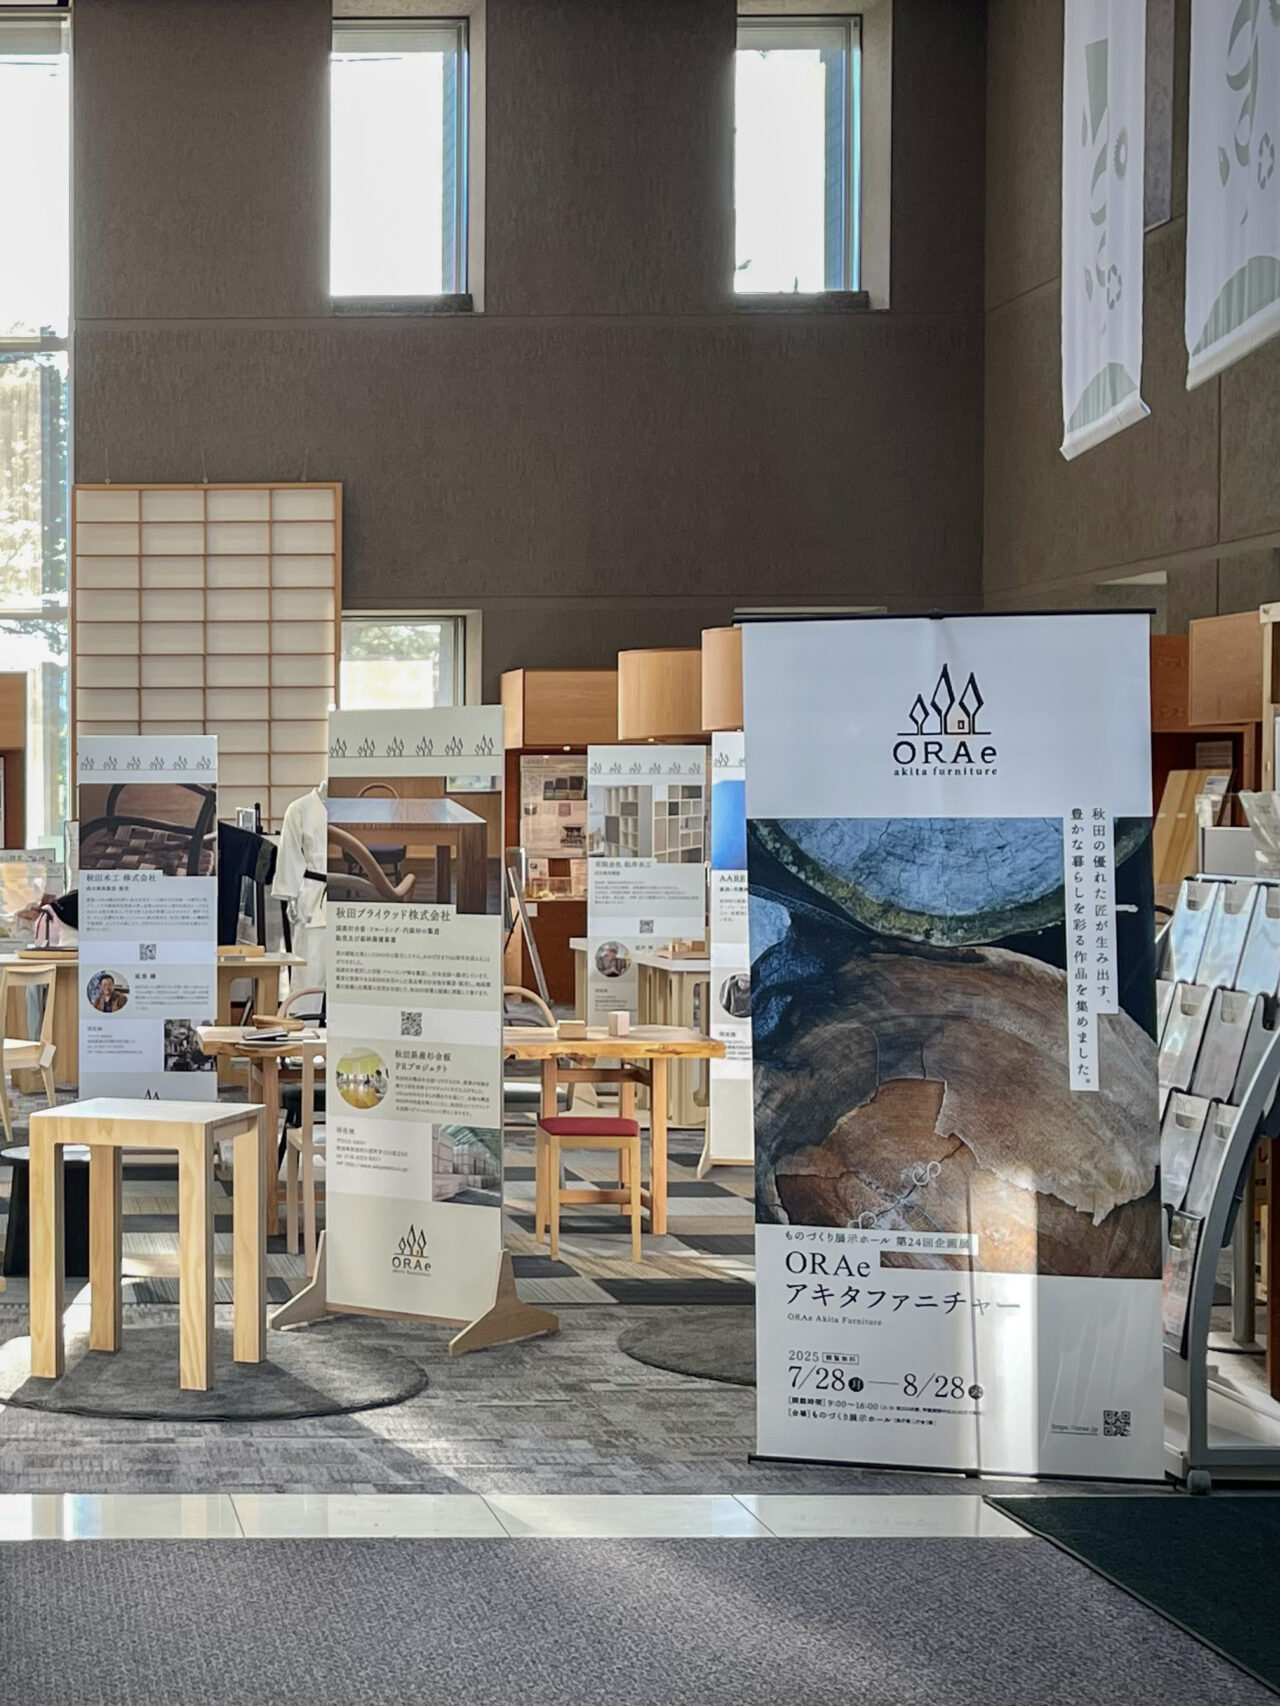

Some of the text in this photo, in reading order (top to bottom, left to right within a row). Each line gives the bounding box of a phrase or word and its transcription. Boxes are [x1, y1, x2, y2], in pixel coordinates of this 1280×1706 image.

[893, 741, 997, 764] ORAe
[894, 766, 997, 776] akita furniture
[336, 906, 452, 922] 秋田プライウッド株式会社
[1092, 807, 1111, 1003] 秋田の優れた匠が生み出す、
[1071, 808, 1091, 1083] 豊かな暮らしを彩る作品を集めました。
[786, 1231, 970, 1249] ものづくり展示ホール 第24回企画展
[392, 1256, 431, 1271] ORAe
[786, 1251, 870, 1277] ORAe
[786, 1283, 1021, 1316] アキタファニチャー
[787, 1313, 882, 1326] ORAe Akita Furniture
[788, 1350, 819, 1362] 2025
[788, 1365, 845, 1392] 7/28
[903, 1373, 965, 1399] 8/28
